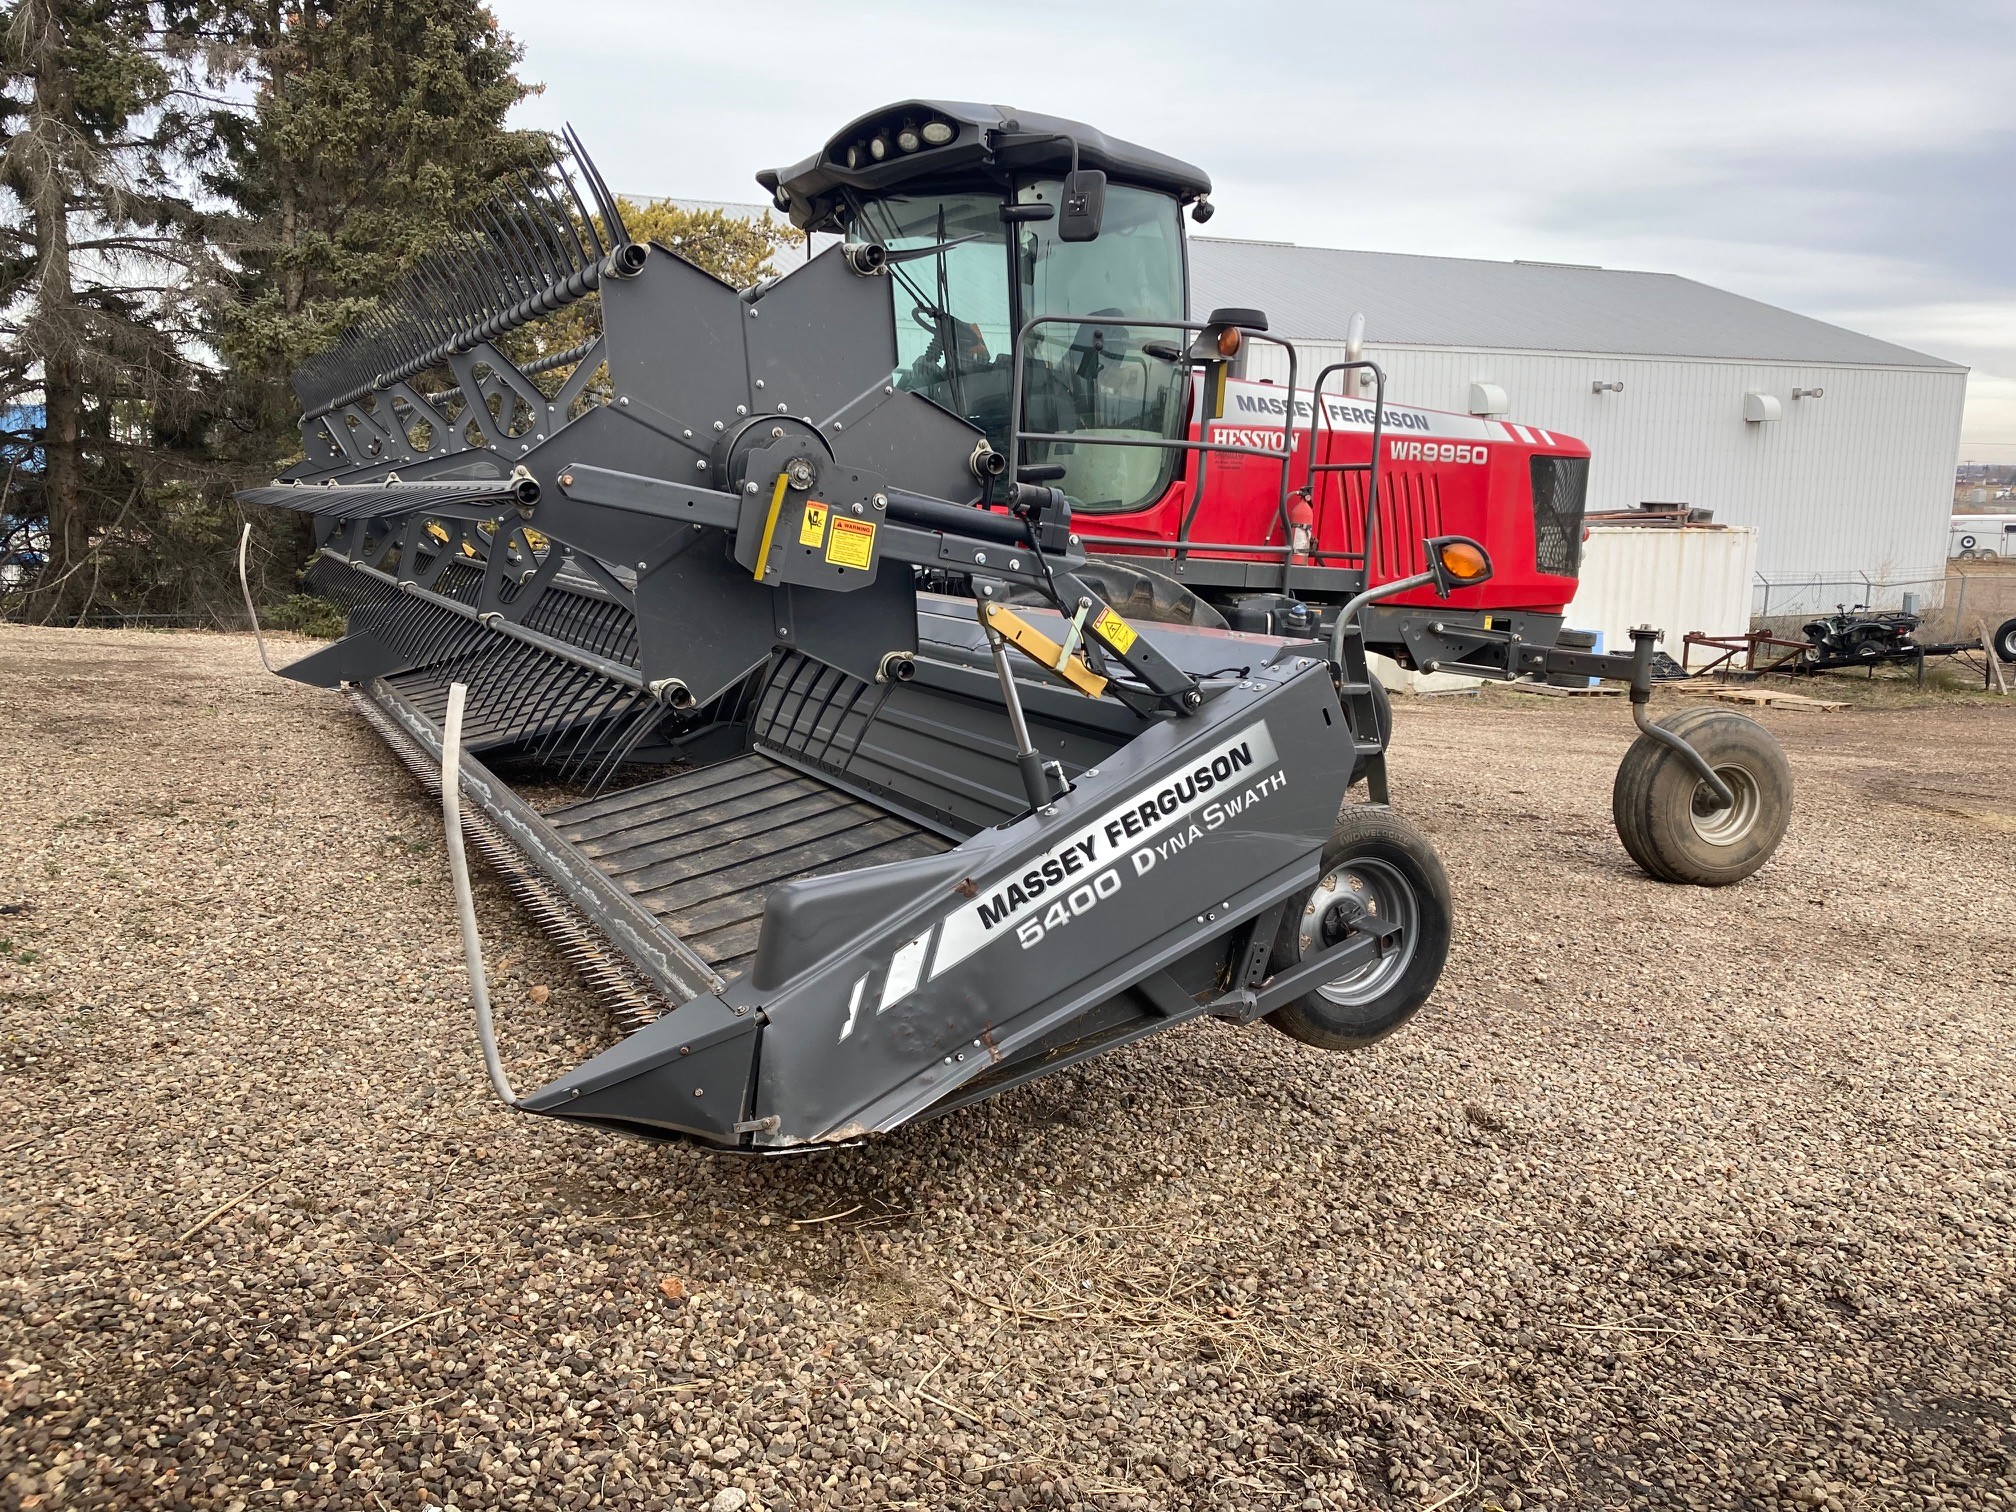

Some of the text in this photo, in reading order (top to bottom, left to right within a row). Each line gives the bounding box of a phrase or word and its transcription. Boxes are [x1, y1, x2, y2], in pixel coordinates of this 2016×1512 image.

[1328, 404, 1430, 431] FERGUSON
[1213, 428, 1300, 453] HESSTON
[1390, 440, 1489, 465] WR9950
[844, 522, 871, 532] WARNING
[976, 742, 1254, 930] MASSEY FERGUSON
[1015, 868, 1122, 950] 5400
